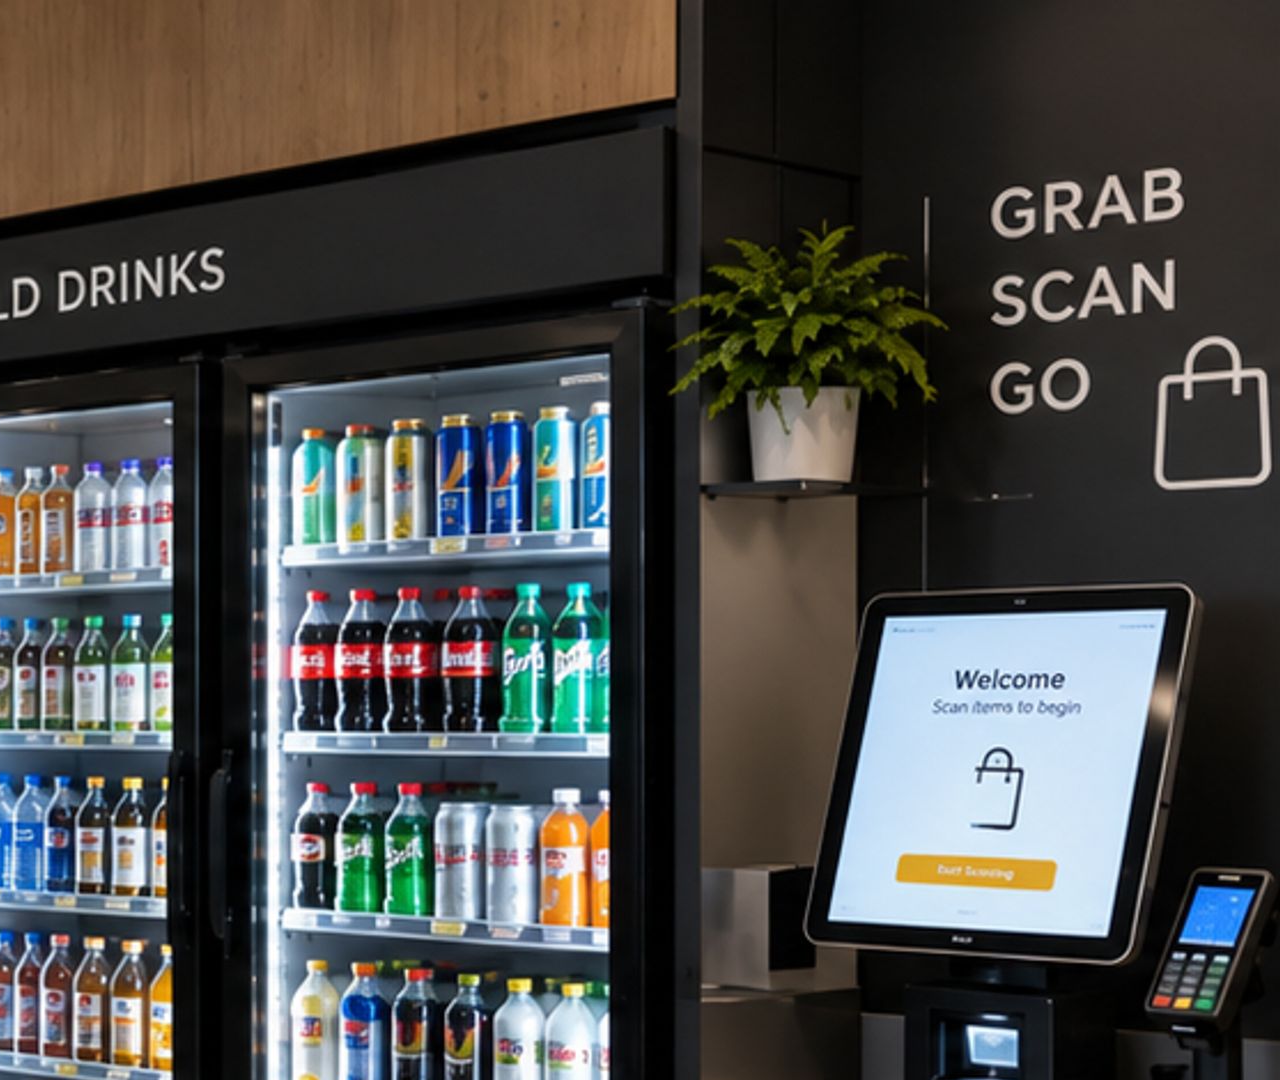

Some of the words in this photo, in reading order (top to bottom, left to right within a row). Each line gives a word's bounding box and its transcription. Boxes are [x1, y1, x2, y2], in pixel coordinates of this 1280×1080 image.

[990, 167, 1185, 239] GRAB
[58, 247, 226, 312] DRINKS
[990, 259, 1176, 326] SCAN
[990, 357, 1091, 416] GO
[932, 699, 969, 715] Scan
[972, 699, 1014, 715] items
[1017, 700, 1034, 715] to
[1037, 699, 1082, 718] begin
[955, 668, 1067, 691] Welcome
